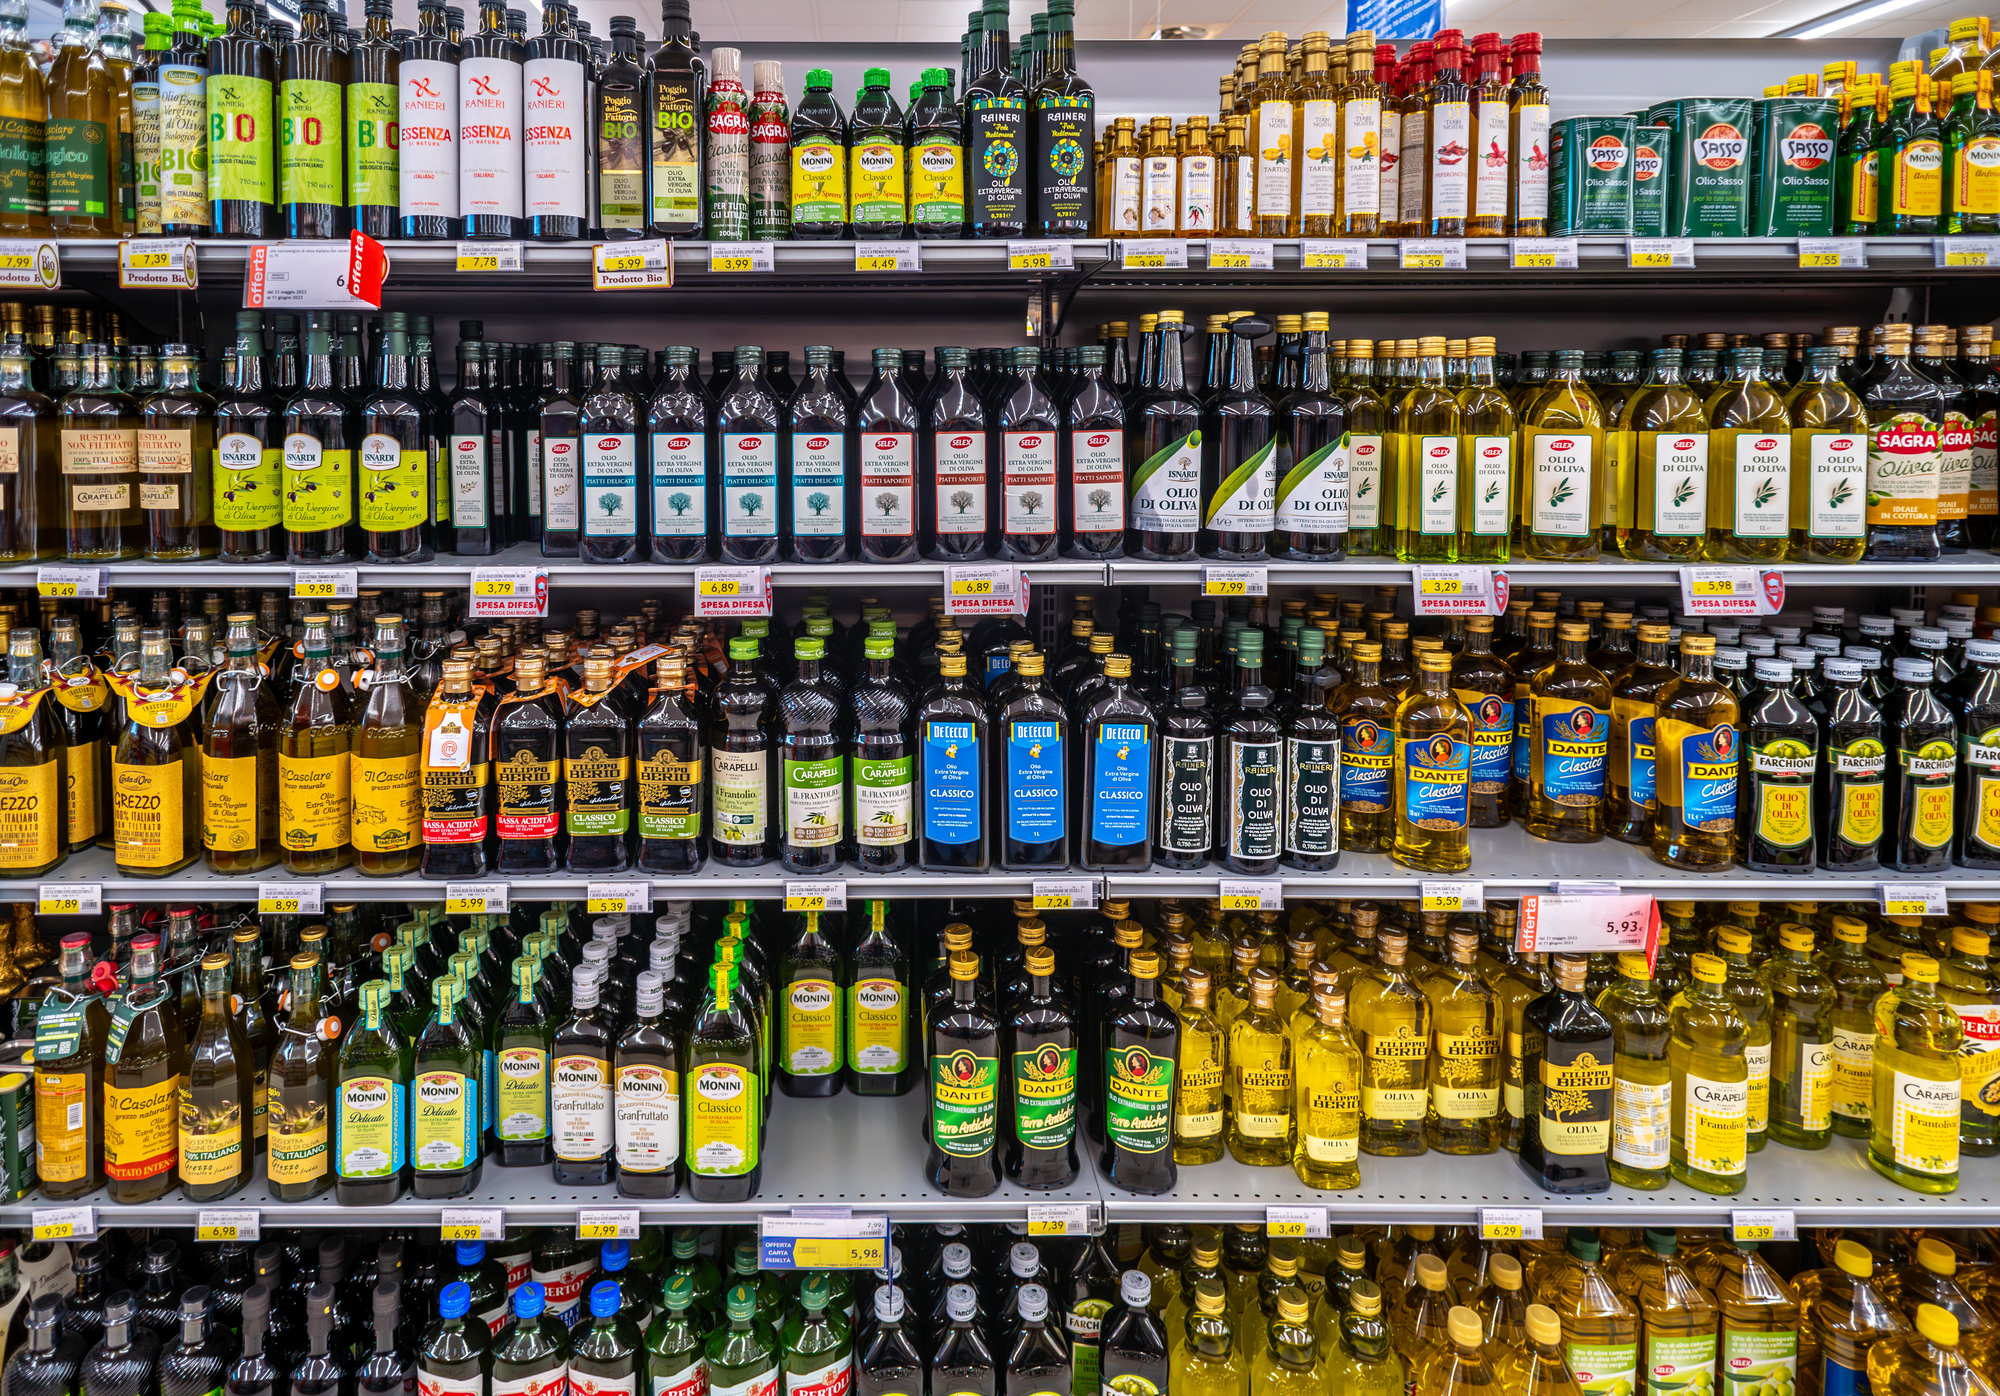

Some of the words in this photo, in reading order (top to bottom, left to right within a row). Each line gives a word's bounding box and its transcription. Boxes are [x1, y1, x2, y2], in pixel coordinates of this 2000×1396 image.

[168, 72, 198, 80] Bartolini
[161, 91, 178, 103] Olio
[179, 95, 206, 107] Extra
[604, 96, 632, 106] Poggio
[164, 105, 198, 117] Vergine
[405, 101, 446, 111] RANIERI
[604, 112, 638, 122] Fattorie
[1048, 113, 1087, 122] RAINERI
[167, 119, 175, 129] di
[177, 118, 205, 130] Oliva
[211, 113, 255, 142] BIO
[709, 116, 747, 129] SAGRA
[402, 126, 451, 142] ESSENZA
[604, 123, 637, 138] BIO
[162, 149, 207, 170] BIO
[1593, 148, 1624, 162] SASSO
[802, 156, 833, 166] MONINI
[1585, 179, 1603, 187] Olio
[1605, 179, 1628, 187] Sasso
[1043, 186, 1088, 194] EXTRAVERGINE
[7, 257, 30, 267] 7,99
[144, 254, 167, 265] 7,39
[474, 257, 497, 268] 7,78
[1023, 258, 1046, 268] 5,98
[1646, 253, 1670, 264] 4,29
[1814, 255, 1837, 266] 7,55
[352, 235, 364, 295] offerta
[618, 259, 640, 270] 5,99
[725, 259, 748, 270] 3,99
[872, 259, 894, 270] 4,49
[128, 273, 168, 283] Prodotto
[251, 248, 264, 304] offerta
[602, 275, 643, 285] Prodotto
[647, 274, 662, 283] Bio
[80, 433, 121, 441] RUSTICO
[1881, 434, 1936, 448] SAGRA
[88, 441, 133, 449] FILTRATO
[877, 439, 898, 449] SELEX
[1552, 441, 1573, 450] SELEX
[364, 453, 395, 462] ISNARDI
[1548, 456, 1576, 464] OLIO
[1553, 465, 1585, 474] OLIVA
[78, 492, 122, 503] CARAPELLI
[1166, 488, 1198, 499] OLIO
[1141, 499, 1154, 509] DI
[1159, 499, 1197, 511] OLIVA
[366, 511, 372, 520] di
[373, 512, 395, 520] Oliva
[51, 586, 74, 597] 8,49
[309, 584, 332, 594] 9,98
[488, 583, 511, 595] 3,79
[711, 583, 734, 594] 6,89
[967, 583, 989, 593] 6,89
[1220, 583, 1243, 593] 7,99
[1434, 582, 1457, 593] 3,29
[1708, 581, 1732, 592] 5,98
[701, 601, 730, 609] SPESA
[1422, 599, 1450, 607] SPESA
[1453, 599, 1486, 607] DIFESA
[1553, 745, 1604, 754] DANTE
[1175, 760, 1206, 770] RAINERI
[1559, 758, 1602, 774] Classico
[1760, 758, 1814, 767] FARCHIONI
[502, 766, 547, 774] FILIPPO
[793, 767, 837, 782] CARAPELLI
[287, 773, 332, 782] Casolare
[500, 773, 550, 782] BERIO
[1180, 783, 1202, 791] OLIO
[1014, 788, 1058, 798] CLASSICO
[1186, 793, 1196, 802] DI
[1775, 794, 1798, 802] OLIO
[115, 795, 160, 810] GREZZO
[1782, 802, 1791, 810] DI
[1178, 804, 1203, 813] OLIVA
[131, 813, 160, 823] ITALIANO
[573, 814, 616, 823] CLASSICO
[1772, 810, 1800, 819] OLIVA
[447, 819, 479, 829] ACIDITÀ
[55, 899, 78, 909] 7,89
[275, 900, 299, 911] 8,99
[460, 898, 483, 908] 5,99
[801, 897, 822, 907] 7,49
[1047, 898, 1069, 908] 7,24
[1234, 898, 1257, 909] 6,90
[1436, 897, 1458, 906] 5,59
[601, 902, 623, 912] 5,39
[1524, 897, 1537, 950] offerta
[1606, 921, 1638, 934] 5,93
[1562, 1070, 1608, 1079] FILIPPO
[699, 1079, 741, 1091] MONINI
[1556, 1076, 1610, 1087] BERIO
[347, 1092, 386, 1103] MONINI
[940, 1087, 990, 1101] DANTE
[1694, 1086, 1746, 1103] CARAPELLI
[553, 1100, 603, 1111] GranFruttato
[697, 1102, 742, 1114] Classico
[348, 1112, 385, 1123] Delicato
[937, 1121, 958, 1134] Terre
[959, 1113, 994, 1132] Antiche
[1700, 1118, 1744, 1129] Frantoliva
[1566, 1125, 1597, 1134] OLIVA
[287, 1143, 325, 1160] ITALIANO
[212, 1225, 236, 1236] 6,98
[593, 1225, 615, 1236] 7,99
[1041, 1220, 1064, 1231] 7,39
[1278, 1225, 1301, 1235] 3,49
[45, 1225, 68, 1238] 9,29
[454, 1229, 477, 1239] 6,99
[1494, 1226, 1516, 1236] 6,29
[1747, 1228, 1769, 1238] 6,39
[851, 1249, 878, 1260] 5,98
